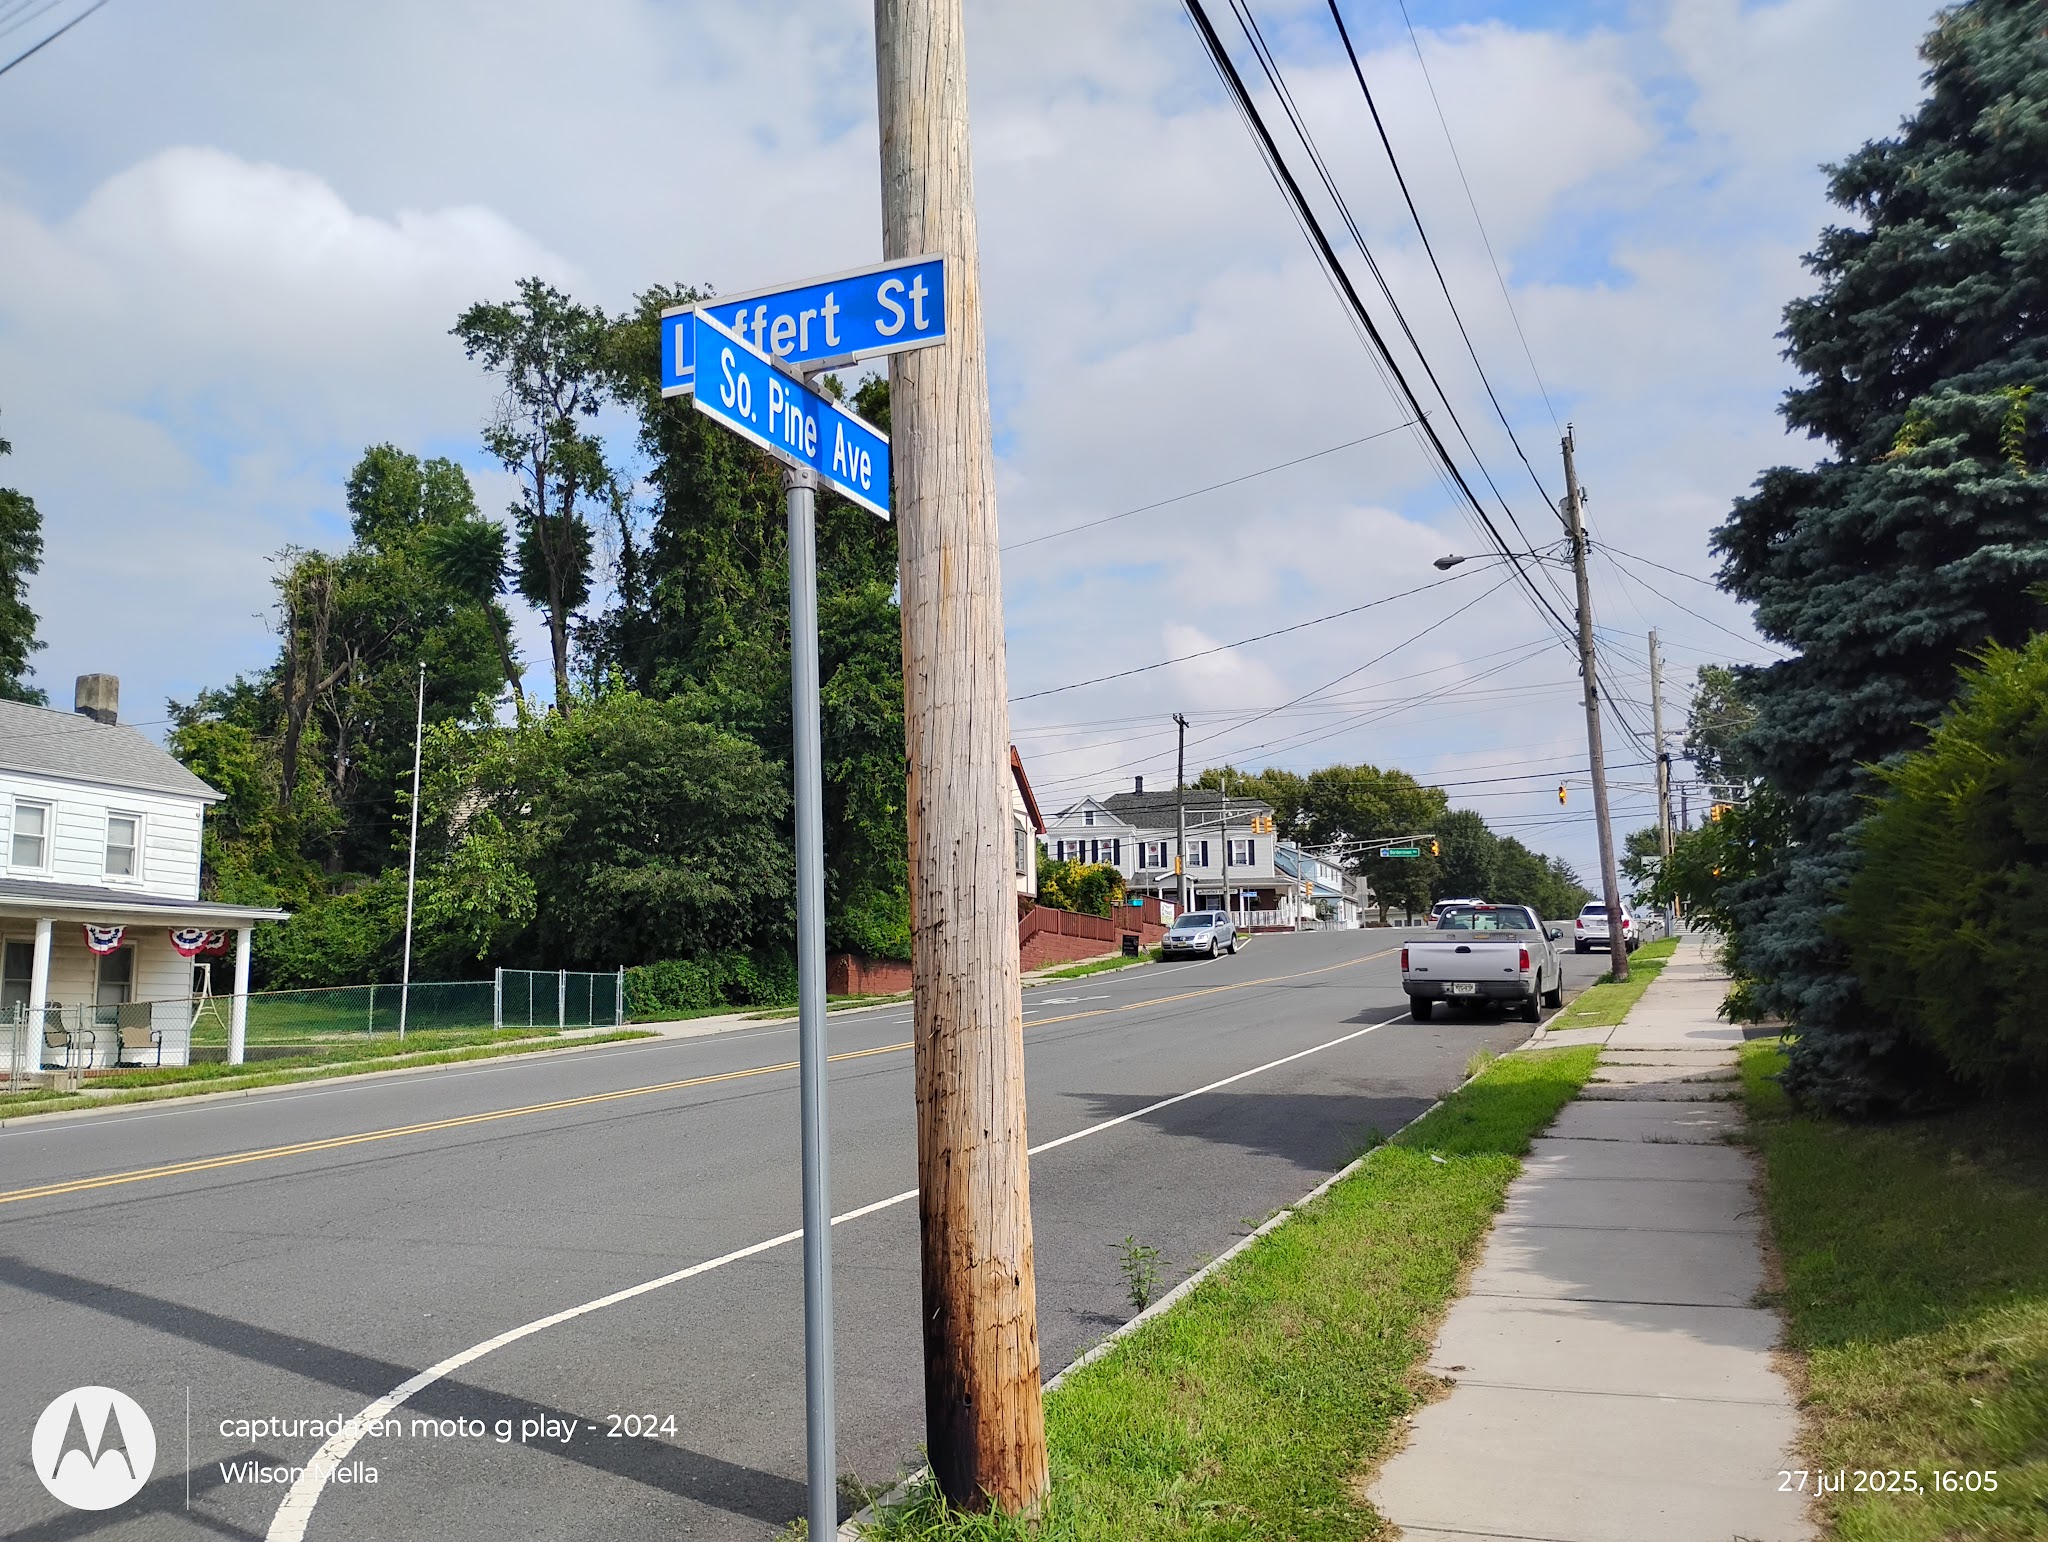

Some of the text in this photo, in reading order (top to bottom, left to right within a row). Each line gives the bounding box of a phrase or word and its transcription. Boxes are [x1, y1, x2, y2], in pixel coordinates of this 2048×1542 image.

[675, 273, 930, 377] Lffert St
[720, 347, 872, 491] So. Pine Ave
